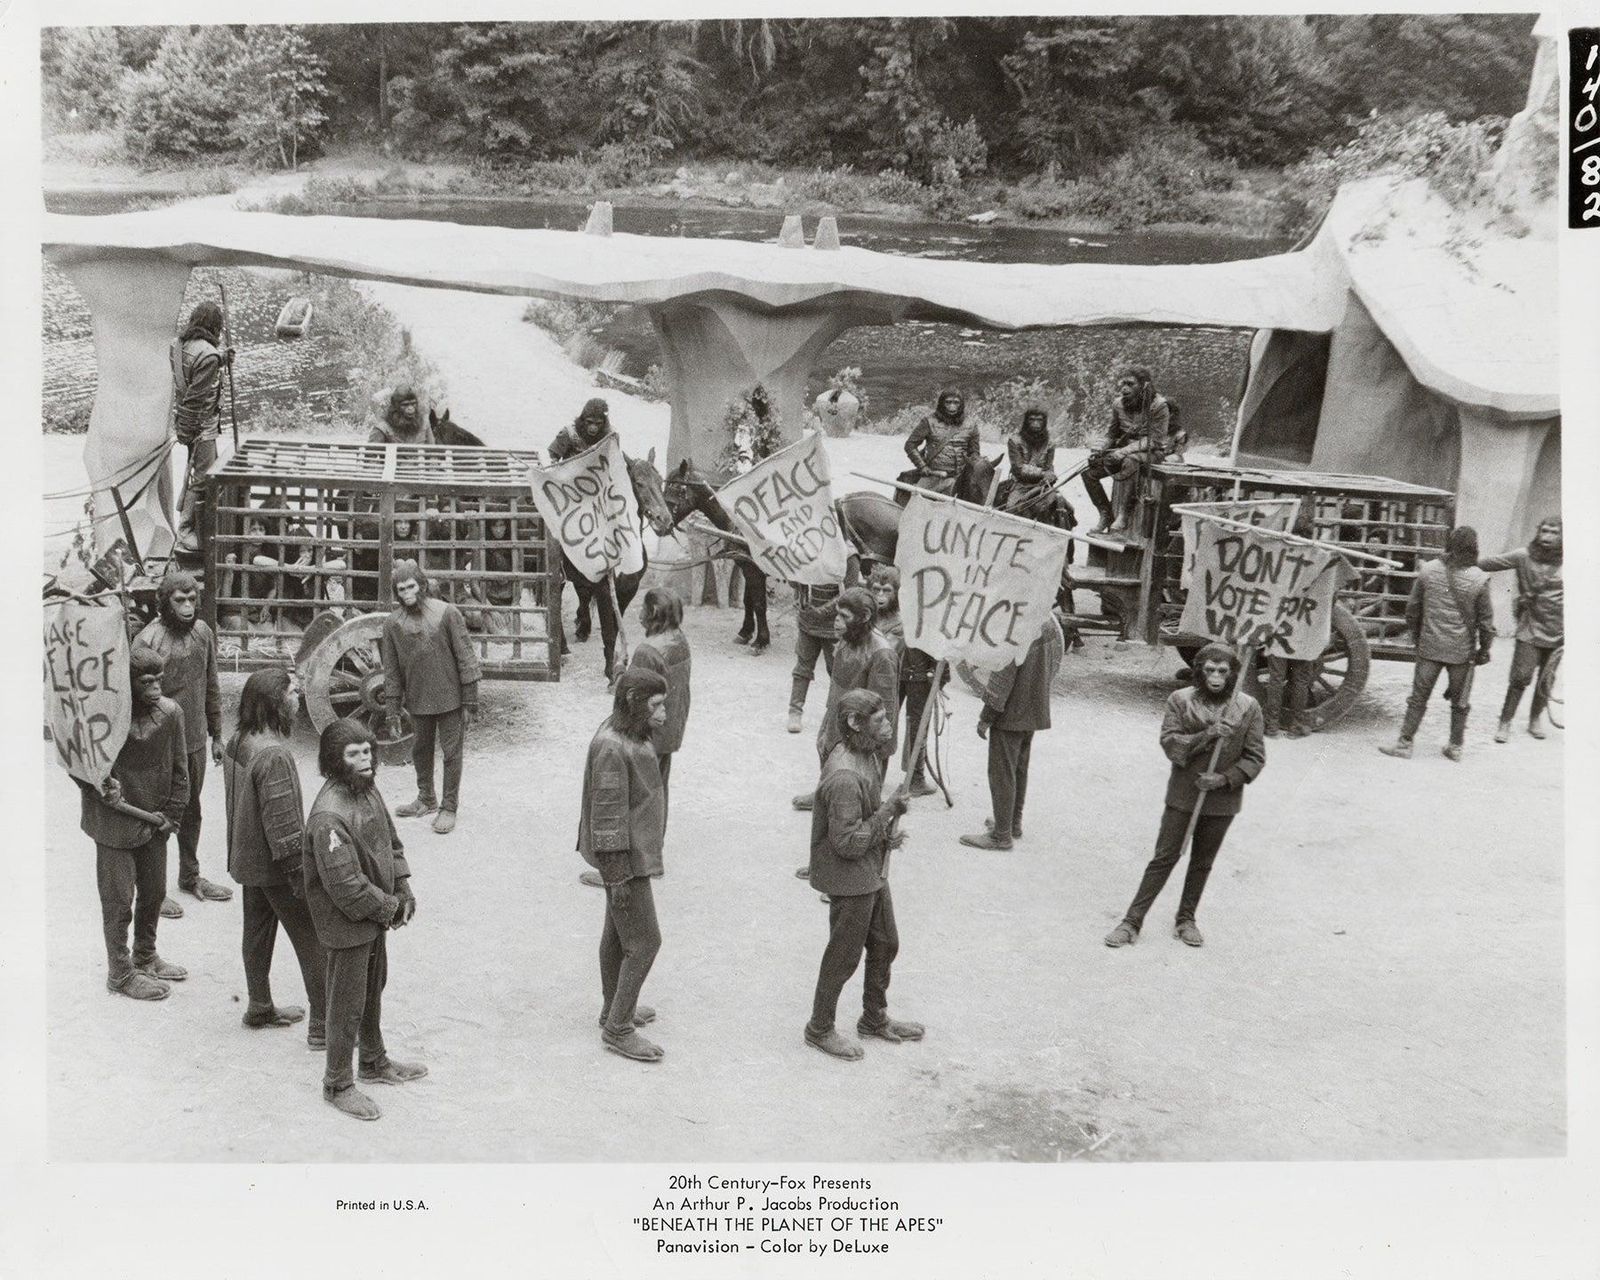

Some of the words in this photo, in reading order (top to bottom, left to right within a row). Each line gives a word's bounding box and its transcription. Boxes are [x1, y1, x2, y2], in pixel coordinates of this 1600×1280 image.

[542, 454, 613, 517] DOOM
[734, 449, 831, 540] PEACE
[561, 484, 627, 547] COMS
[780, 504, 813, 540] AND
[923, 520, 1033, 574] UNITE
[1213, 536, 1314, 593] DON'T
[964, 564, 993, 588] IN
[1205, 569, 1271, 617] VOTE
[912, 565, 1028, 648] PEACE
[1205, 608, 1296, 655] WAR
[43, 617, 89, 649] AGE
[43, 645, 118, 694] EACE
[60, 693, 90, 720] NT
[51, 712, 112, 770] WAR
